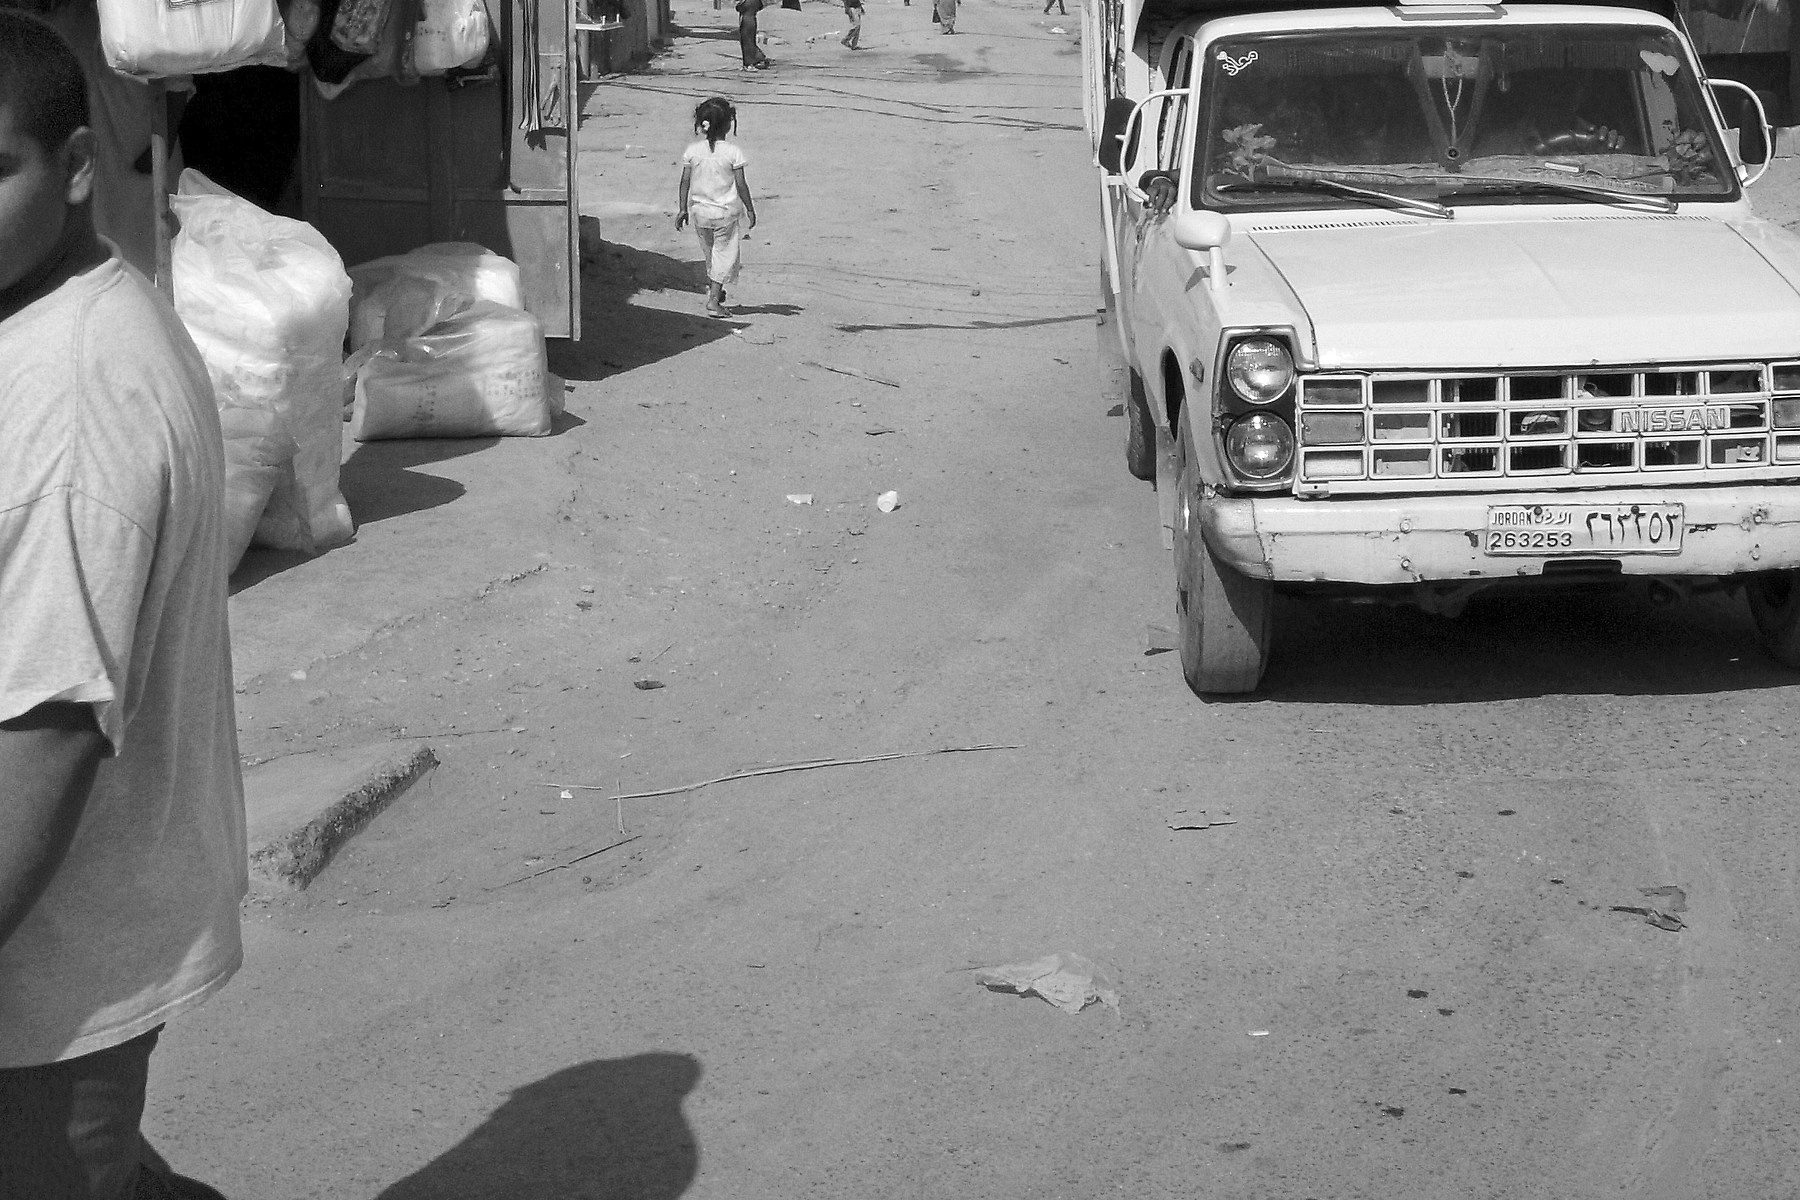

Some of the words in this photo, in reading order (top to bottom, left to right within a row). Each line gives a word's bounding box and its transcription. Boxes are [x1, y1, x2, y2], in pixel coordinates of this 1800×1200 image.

[1620, 407, 1726, 432] NISSAN
[1491, 511, 1532, 526] JORDAN
[1489, 532, 1573, 548] 263253
